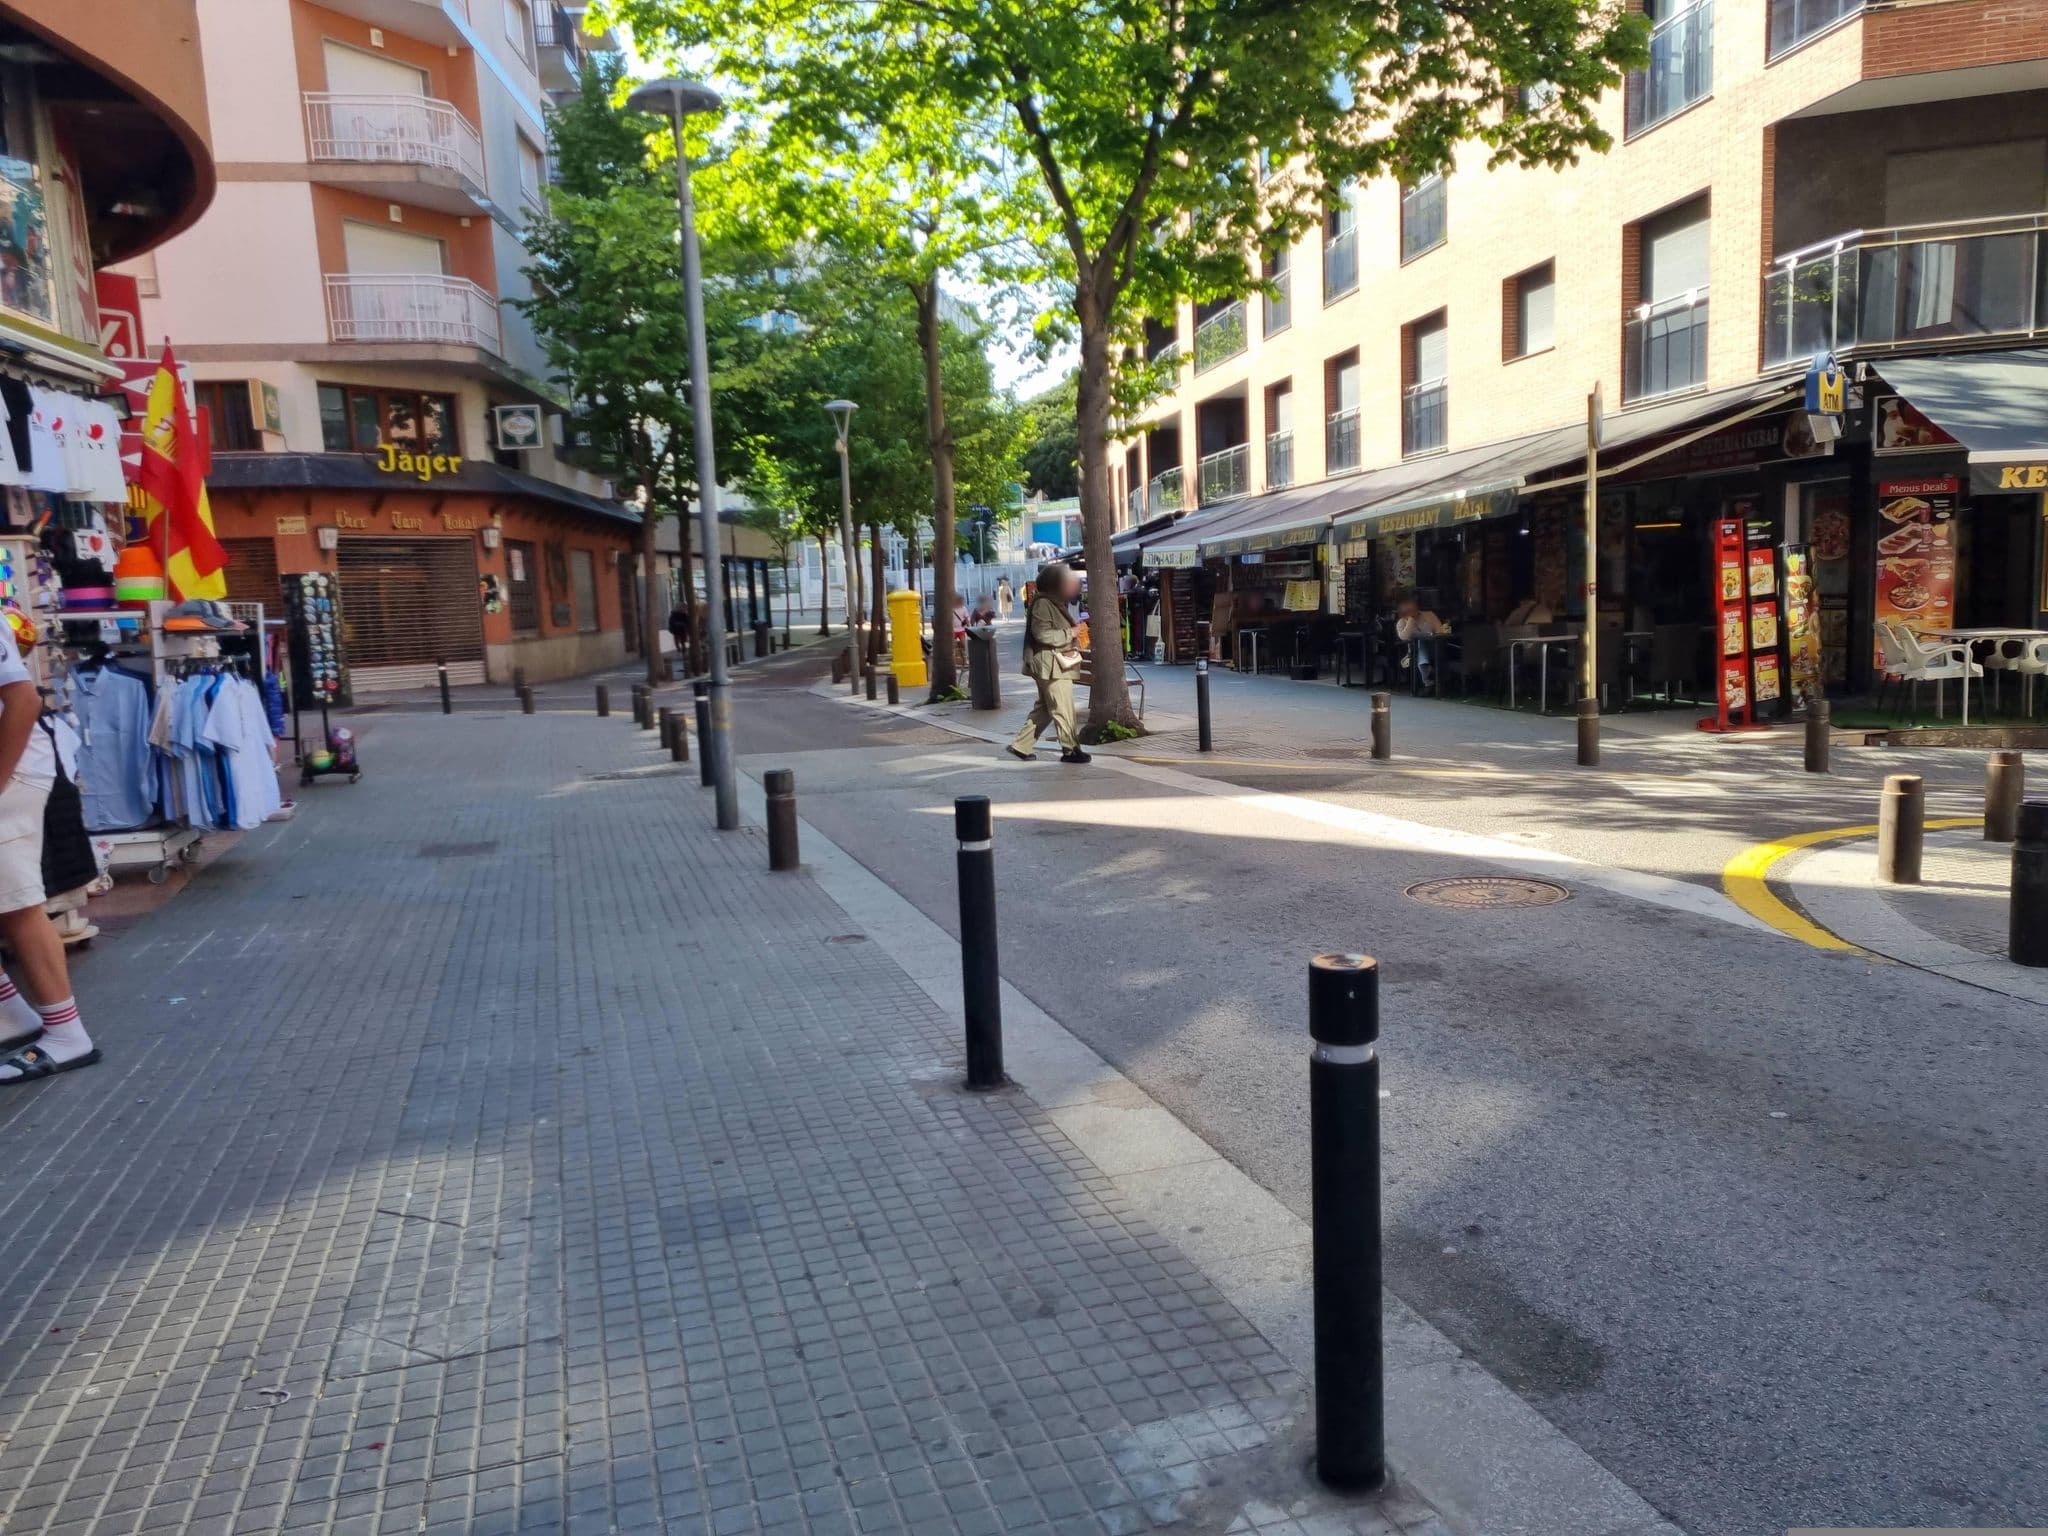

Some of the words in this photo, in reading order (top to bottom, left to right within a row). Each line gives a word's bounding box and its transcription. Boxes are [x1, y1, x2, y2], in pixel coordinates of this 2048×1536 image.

[1823, 392, 1840, 410] ATM
[377, 443, 463, 482] Jäger
[1889, 483, 1920, 494] Menus
[1923, 482, 1948, 493] Deals
[1378, 507, 1441, 534] RESTAURANT
